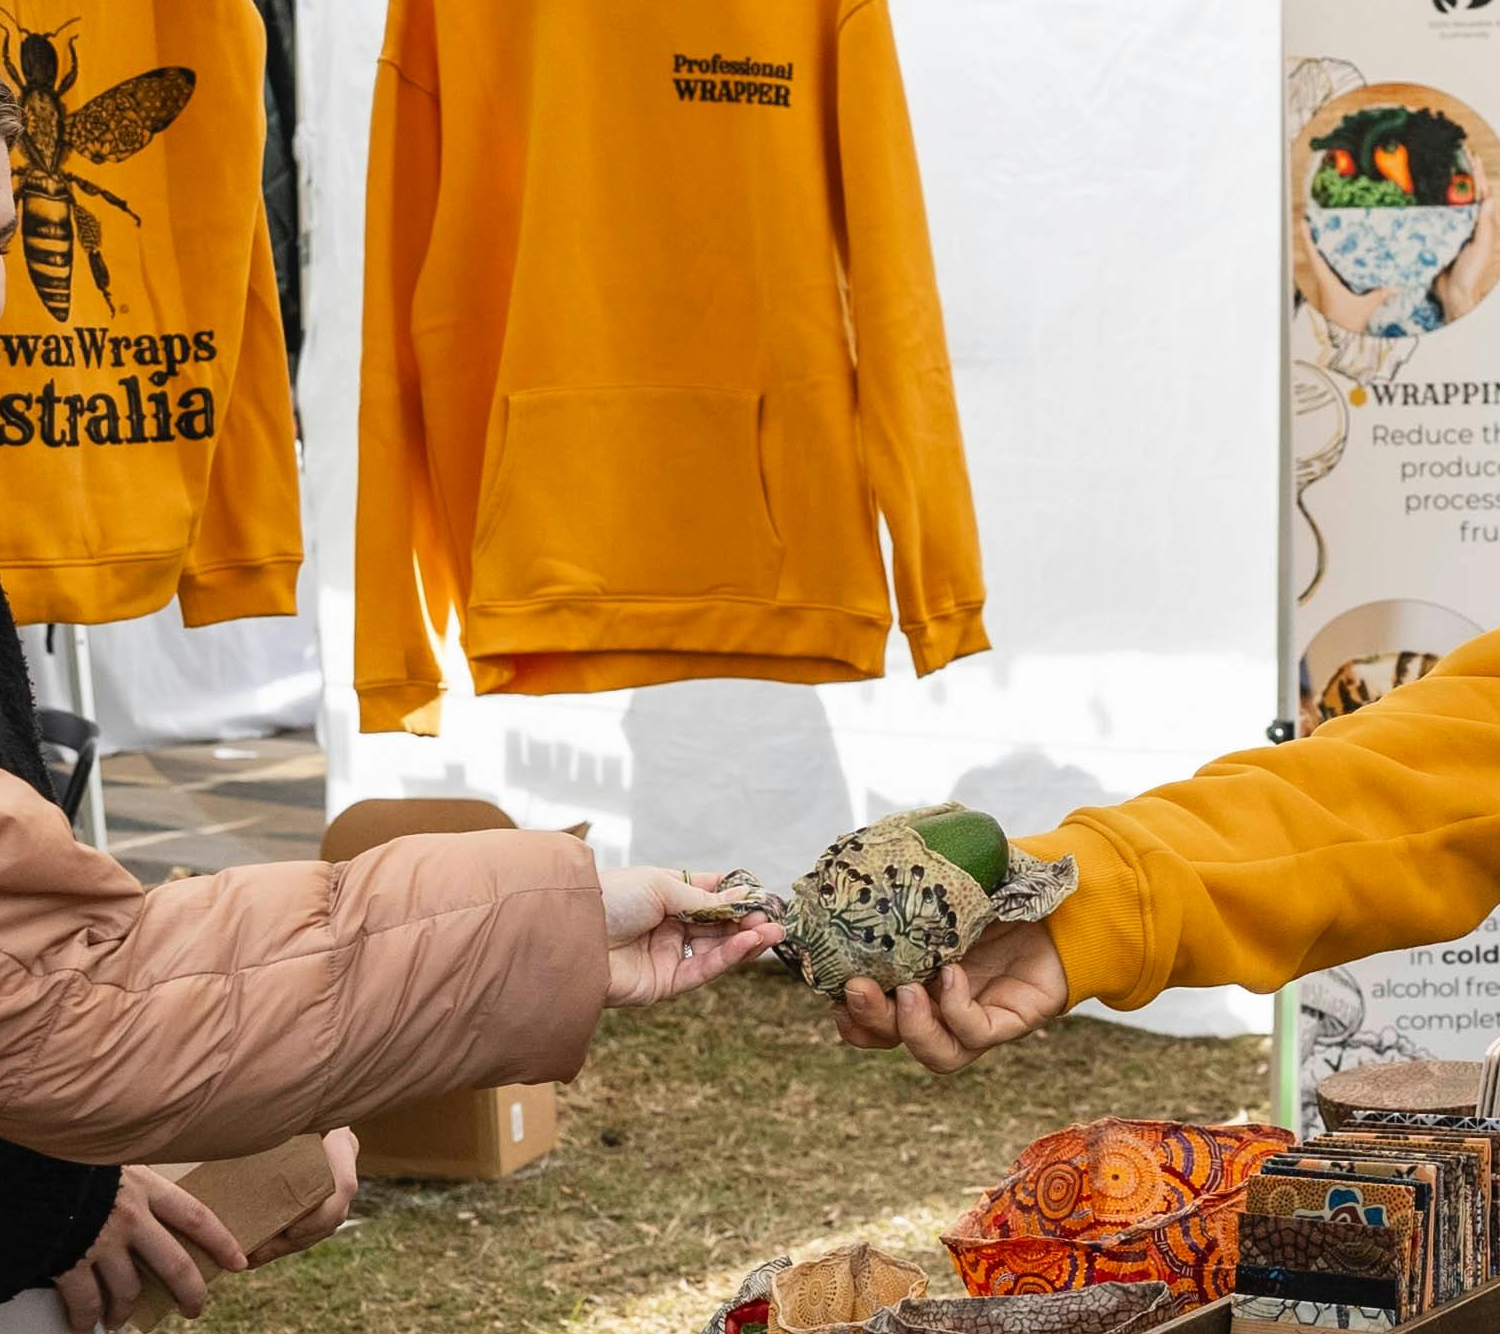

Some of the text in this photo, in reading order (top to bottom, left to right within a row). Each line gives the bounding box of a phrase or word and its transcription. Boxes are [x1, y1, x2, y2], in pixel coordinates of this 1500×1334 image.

[672, 52, 794, 82] Professional
[673, 76, 793, 109] WRAPPER
[73, 327, 217, 377] Wraps
[1372, 424, 1473, 447] Reduce
[1409, 948, 1433, 966] in
[1442, 945, 1500, 965] cold
[1372, 979, 1459, 999] alcohol
